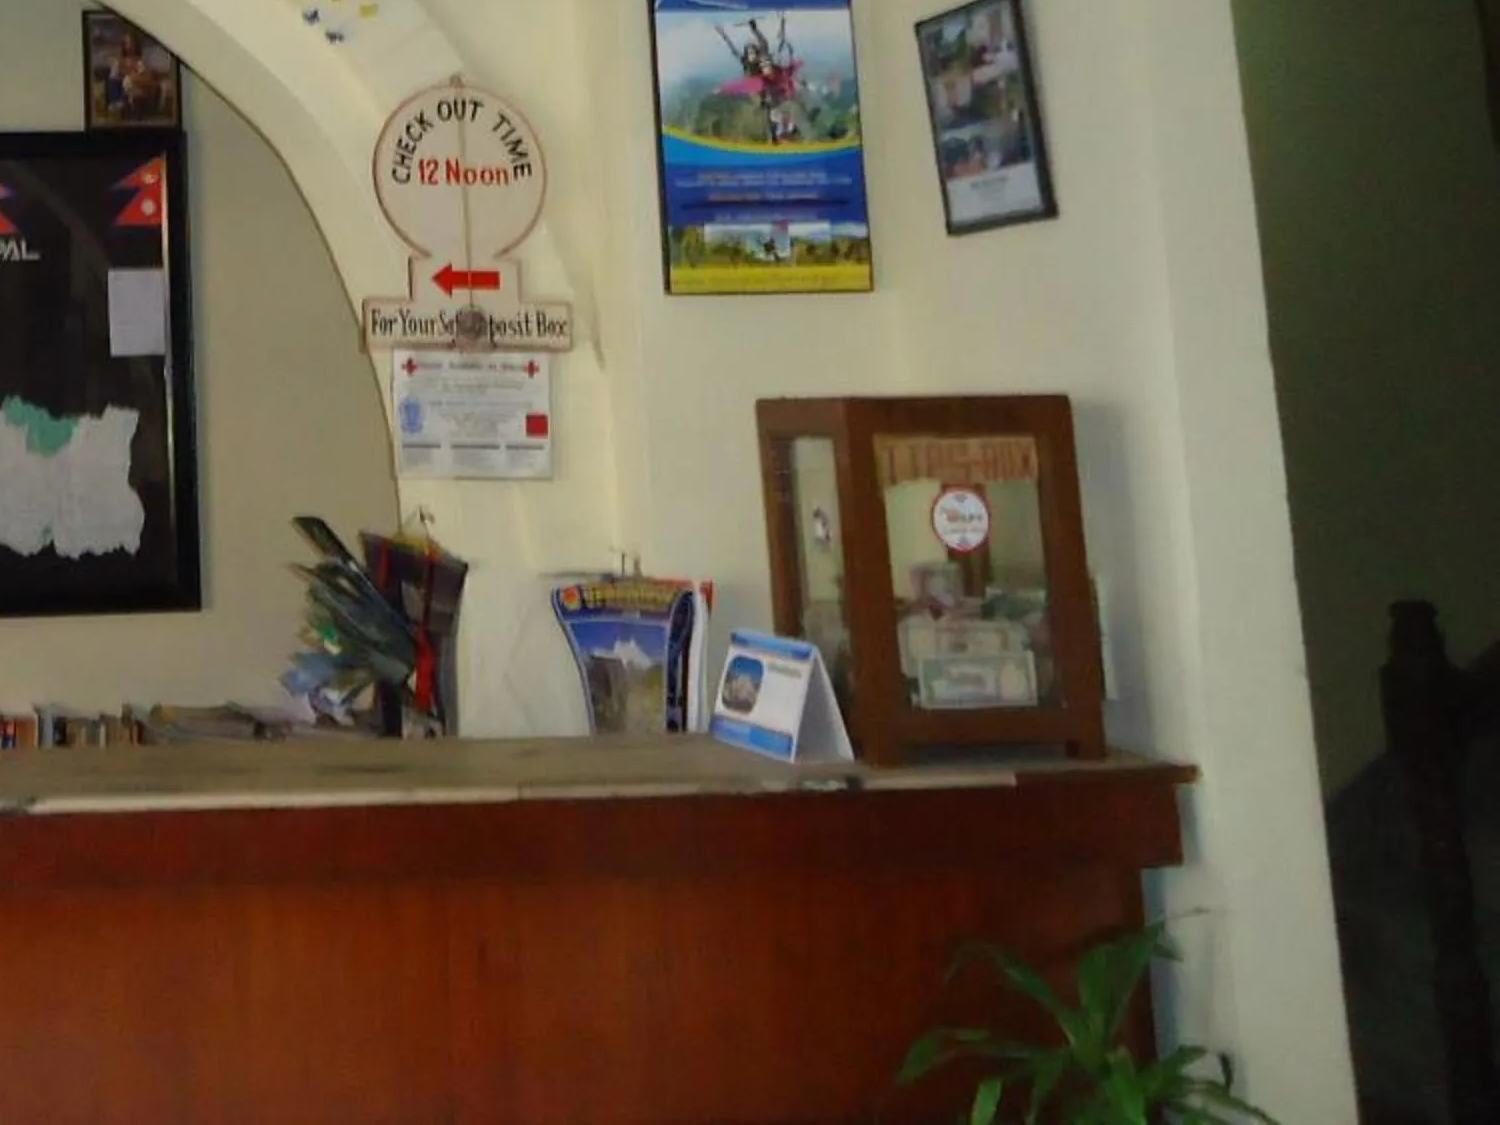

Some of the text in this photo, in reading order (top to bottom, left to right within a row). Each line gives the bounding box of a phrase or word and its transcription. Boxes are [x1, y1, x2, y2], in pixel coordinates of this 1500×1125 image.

[392, 98, 532, 184] CHECK OUT TIME
[418, 158, 509, 186] 12 Noon
[371, 308, 399, 336] For
[400, 308, 436, 339] Your
[439, 309, 467, 339] Saf
[536, 309, 567, 338] Box
